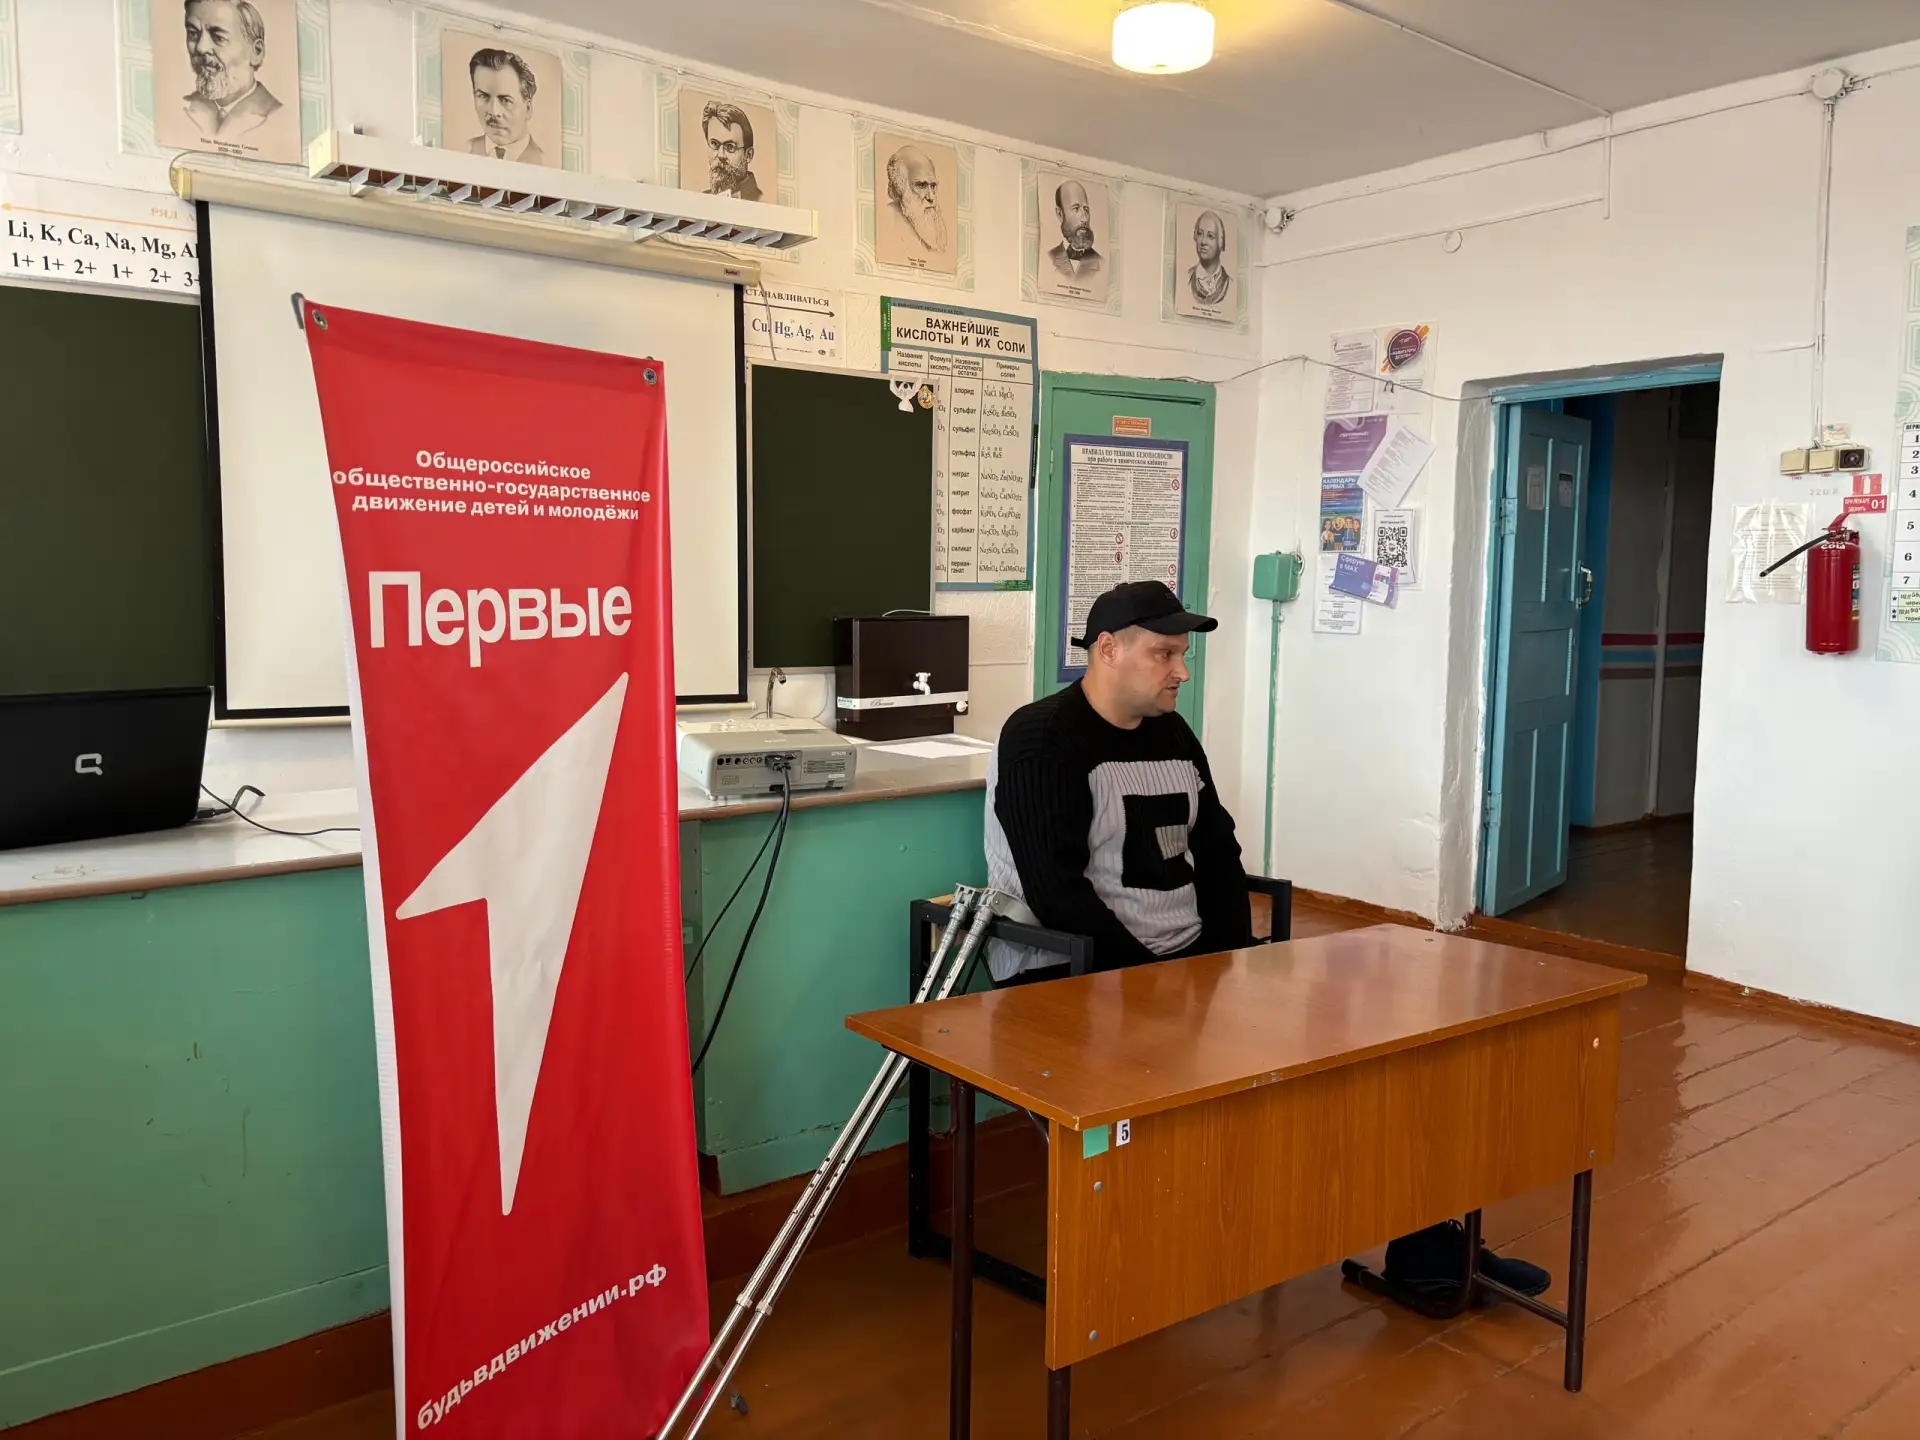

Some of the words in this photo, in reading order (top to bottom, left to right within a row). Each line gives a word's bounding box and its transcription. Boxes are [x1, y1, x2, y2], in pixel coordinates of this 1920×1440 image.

[8, 220, 34, 242] Li,
[40, 224, 63, 245] K,
[68, 227, 100, 250] Ca,
[105, 232, 136, 254] Na,
[142, 237, 176, 259] Mg,
[12, 252, 35, 267] 1+
[42, 255, 64, 271] 1+
[74, 259, 97, 274] 2+
[112, 264, 133, 278] 1+
[150, 268, 172, 283] 2+
[775, 321, 794, 338] Hg,
[796, 324, 814, 341] Ag,
[820, 328, 834, 340] Au
[926, 317, 999, 337] ВАЖНЕЙШИЕ
[896, 327, 954, 344] КИСЛОТЫ
[962, 336, 968, 346] И
[976, 338, 990, 348] ИХ
[998, 340, 1026, 353] СОЛИ
[896, 350, 923, 360] Название
[930, 354, 952, 363] Формула
[898, 360, 921, 368] кислоты
[955, 358, 980, 366] Название
[996, 362, 1020, 371] Примеры
[930, 364, 950, 372] кислоты
[954, 406, 976, 414] сульфат
[1914, 434, 1920, 442] 1
[1912, 450, 1920, 458] 2
[416, 450, 591, 479] Общероссийское
[1911, 466, 1918, 474] 3
[332, 467, 650, 502] общественно-государственное
[952, 490, 970, 498] нитрит
[1909, 490, 1916, 498] 4
[352, 494, 466, 514] движение
[470, 500, 530, 516] детей
[533, 505, 545, 516] и
[548, 506, 639, 521] молодёжи
[1871, 499, 1885, 509] 01
[1907, 522, 1914, 530] 5
[1904, 552, 1912, 561] 6
[1903, 576, 1910, 584] 7
[368, 571, 632, 668] Первые
[1122, 1123, 1129, 1142] 5
[417, 1263, 667, 1430] будьвдвижении.рф
